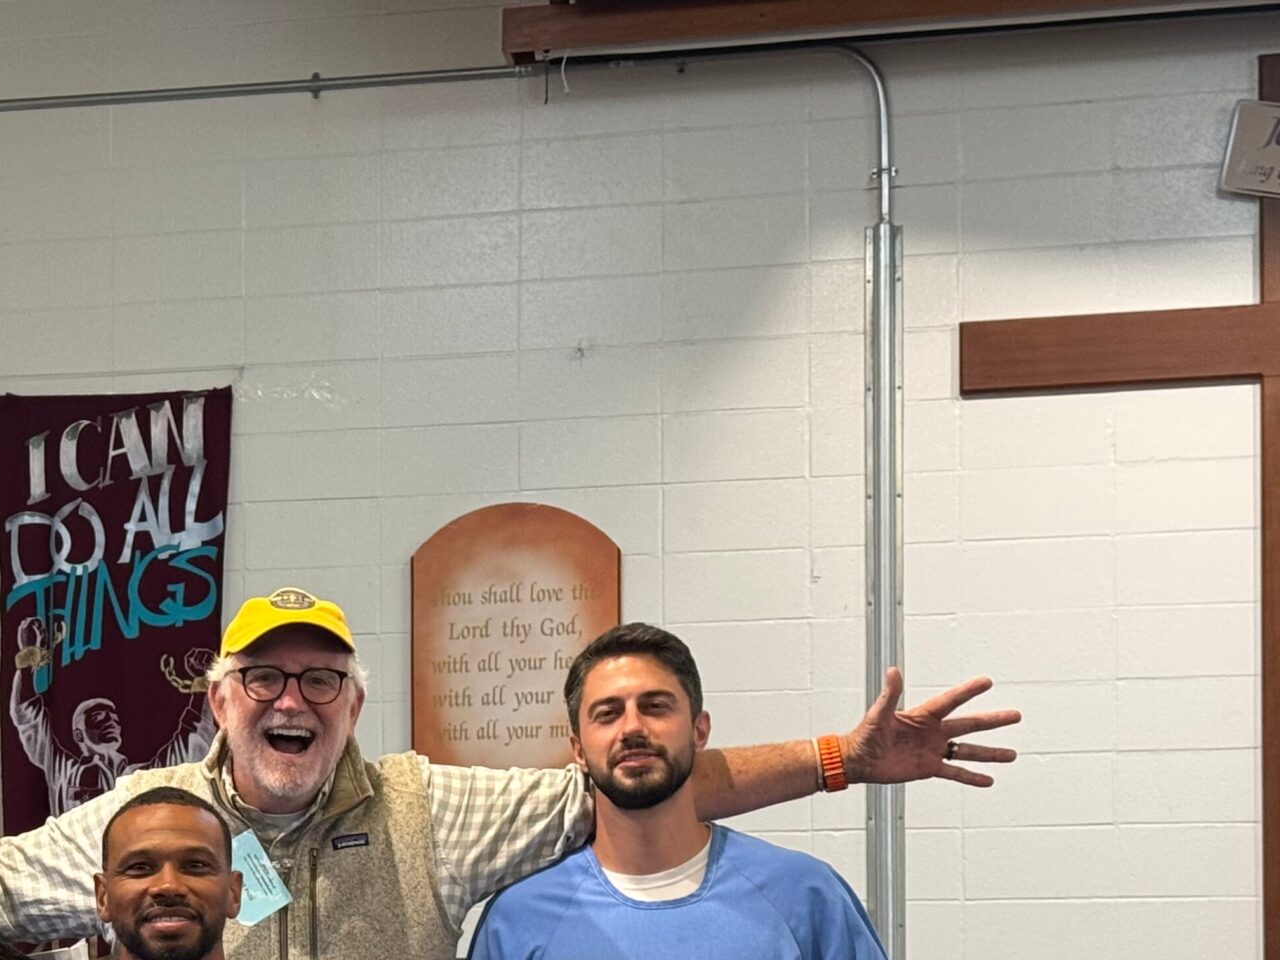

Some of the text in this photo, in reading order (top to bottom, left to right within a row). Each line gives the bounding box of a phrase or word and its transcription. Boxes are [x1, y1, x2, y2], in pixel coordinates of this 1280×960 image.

[24, 391, 208, 505] I CAN
[5, 461, 224, 590] DO ALL
[480, 581, 523, 607] shall
[530, 582, 564, 603] love
[6, 542, 220, 693] THINGS
[448, 614, 583, 644] Lord thy God,
[432, 652, 469, 674] with
[477, 650, 501, 673] all
[506, 656, 547, 679] your
[432, 686, 473, 708] with
[480, 684, 507, 707] all
[512, 690, 555, 712] your
[476, 718, 500, 741] all
[503, 724, 543, 747] your
